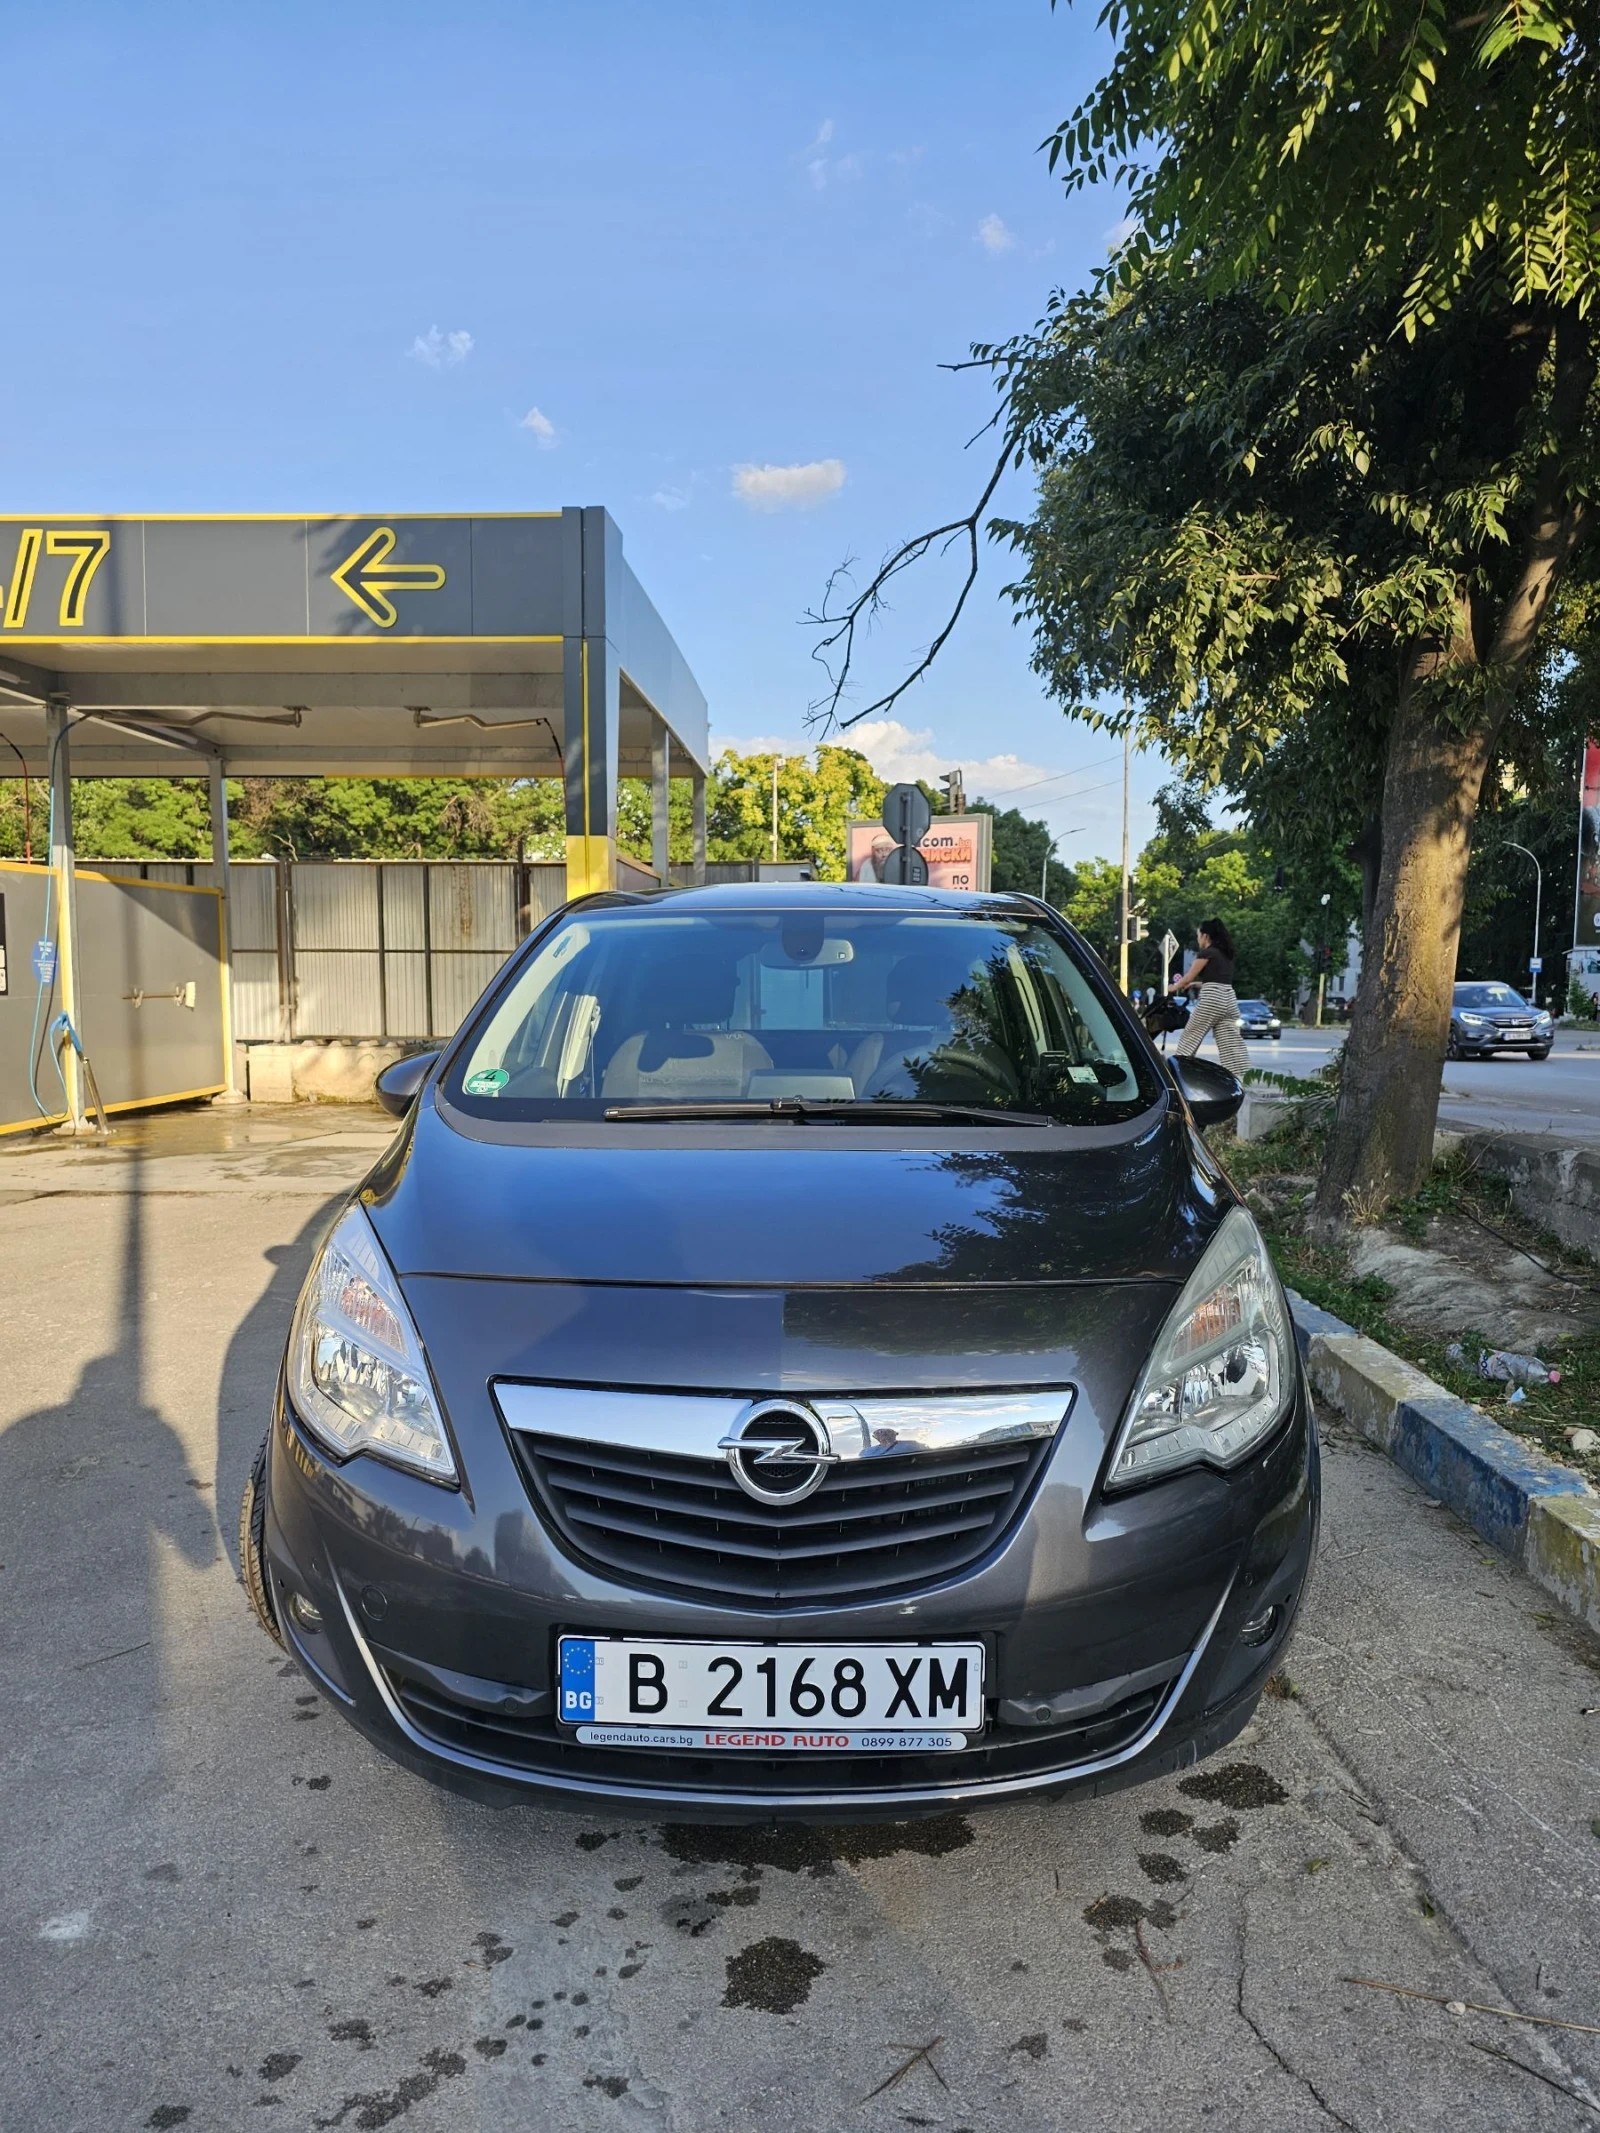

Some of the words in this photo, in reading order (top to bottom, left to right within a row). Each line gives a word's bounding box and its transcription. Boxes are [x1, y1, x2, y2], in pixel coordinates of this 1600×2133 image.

[0, 528, 110, 629] /7
[484, 1070, 497, 1082] 4
[629, 1653, 668, 1714] B
[707, 1656, 867, 1718] 2168
[884, 1657, 968, 1718] XM
[565, 1690, 592, 1710] BG
[590, 1731, 693, 1746] legendauto.cars.bg
[705, 1733, 786, 1747] LEGEND
[793, 1735, 850, 1748] AUTO
[861, 1737, 895, 1747] 0899
[899, 1737, 923, 1747] 877
[928, 1737, 953, 1747] 305
